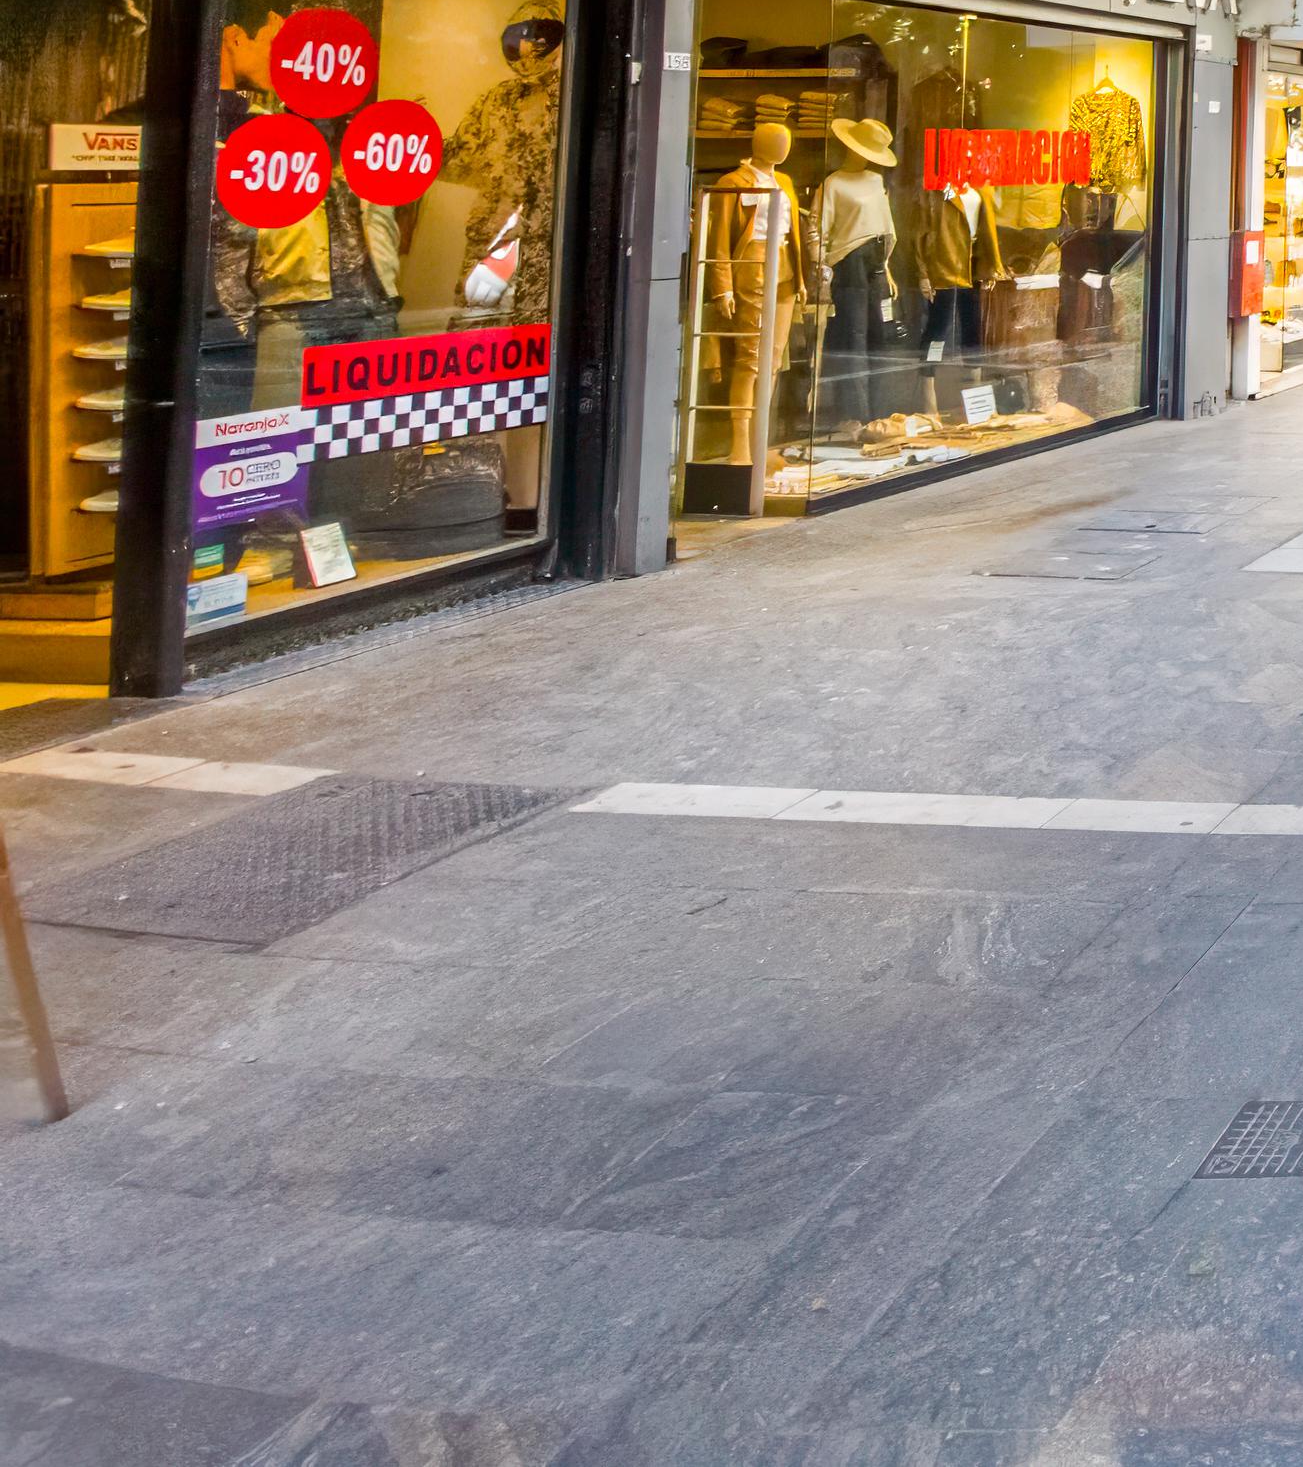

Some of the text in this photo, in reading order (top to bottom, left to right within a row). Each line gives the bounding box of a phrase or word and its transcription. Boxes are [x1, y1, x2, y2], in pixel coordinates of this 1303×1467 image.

[281, 41, 366, 86] -40%
[230, 150, 320, 194] -30%
[353, 132, 432, 175] -60%
[215, 416, 277, 437] Naranja
[218, 466, 245, 490] 10
